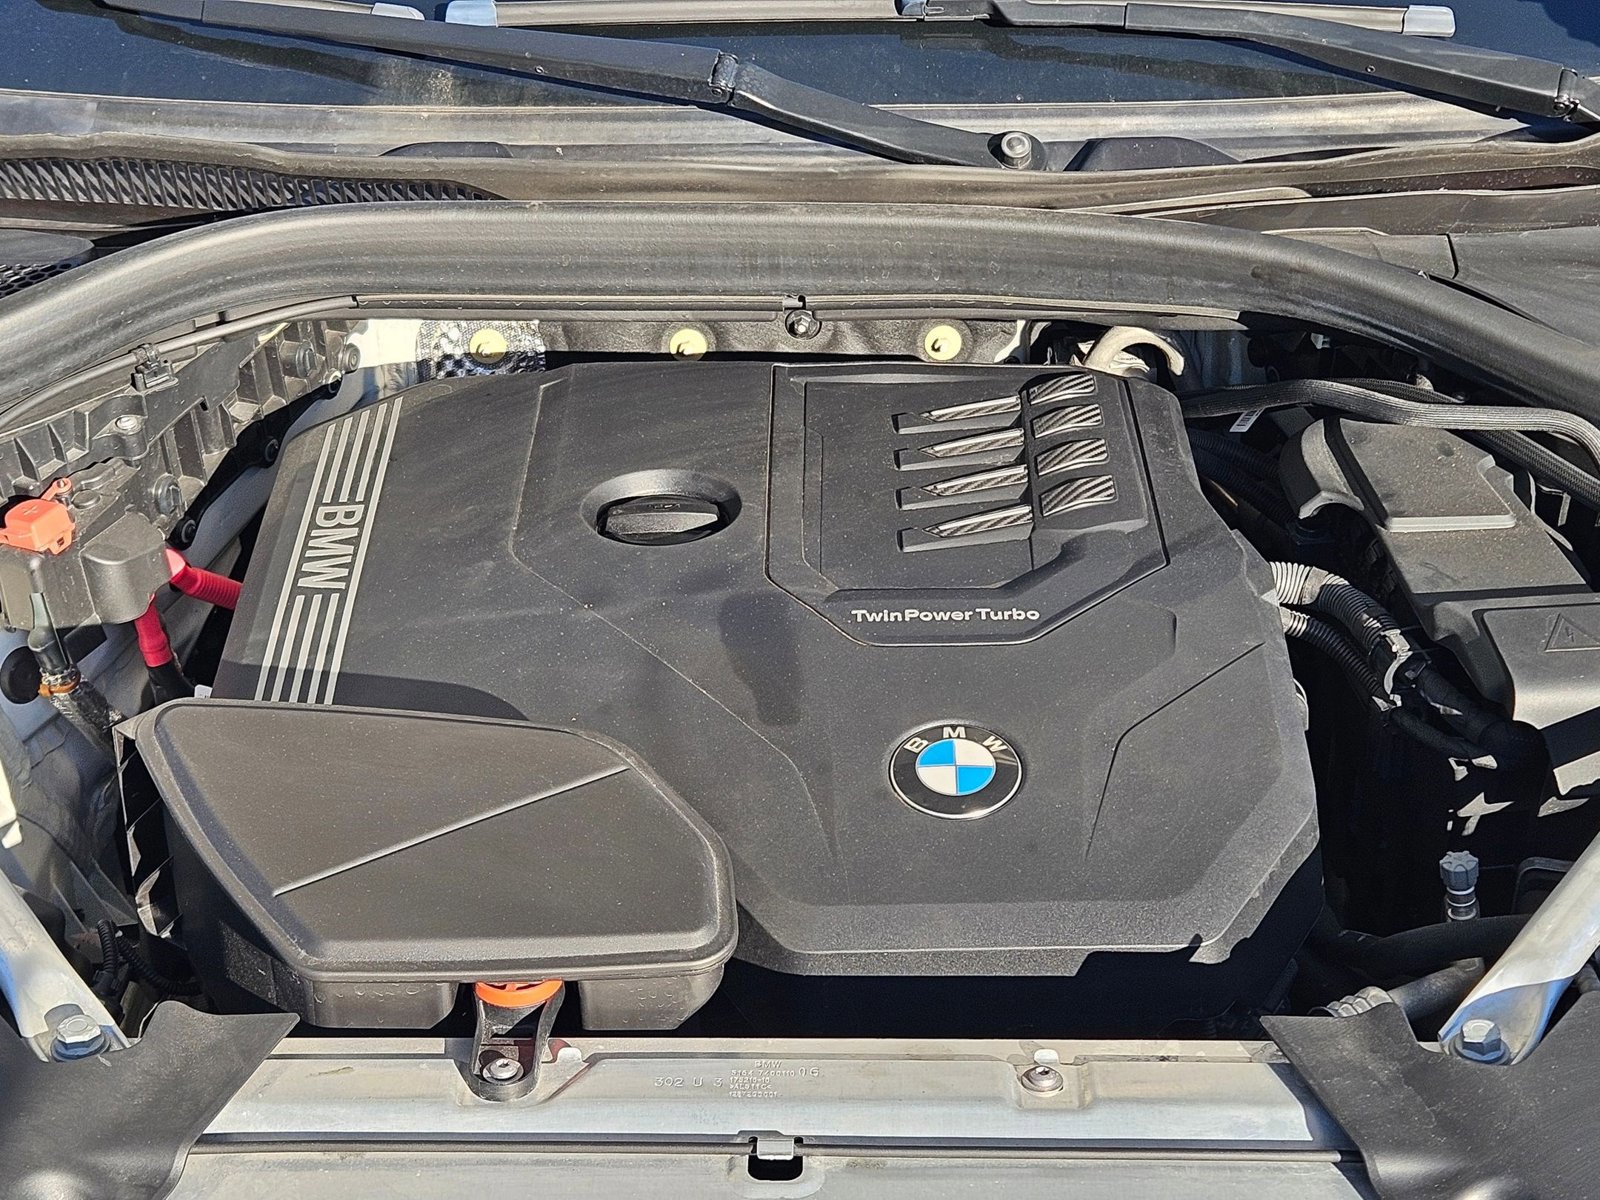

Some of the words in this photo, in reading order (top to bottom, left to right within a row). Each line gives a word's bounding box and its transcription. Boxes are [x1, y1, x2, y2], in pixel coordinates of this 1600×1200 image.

[297, 505, 365, 589] BMW
[975, 607, 1040, 620] Turbo
[903, 726, 1008, 753] BMW
[754, 1060, 782, 1068] BMW
